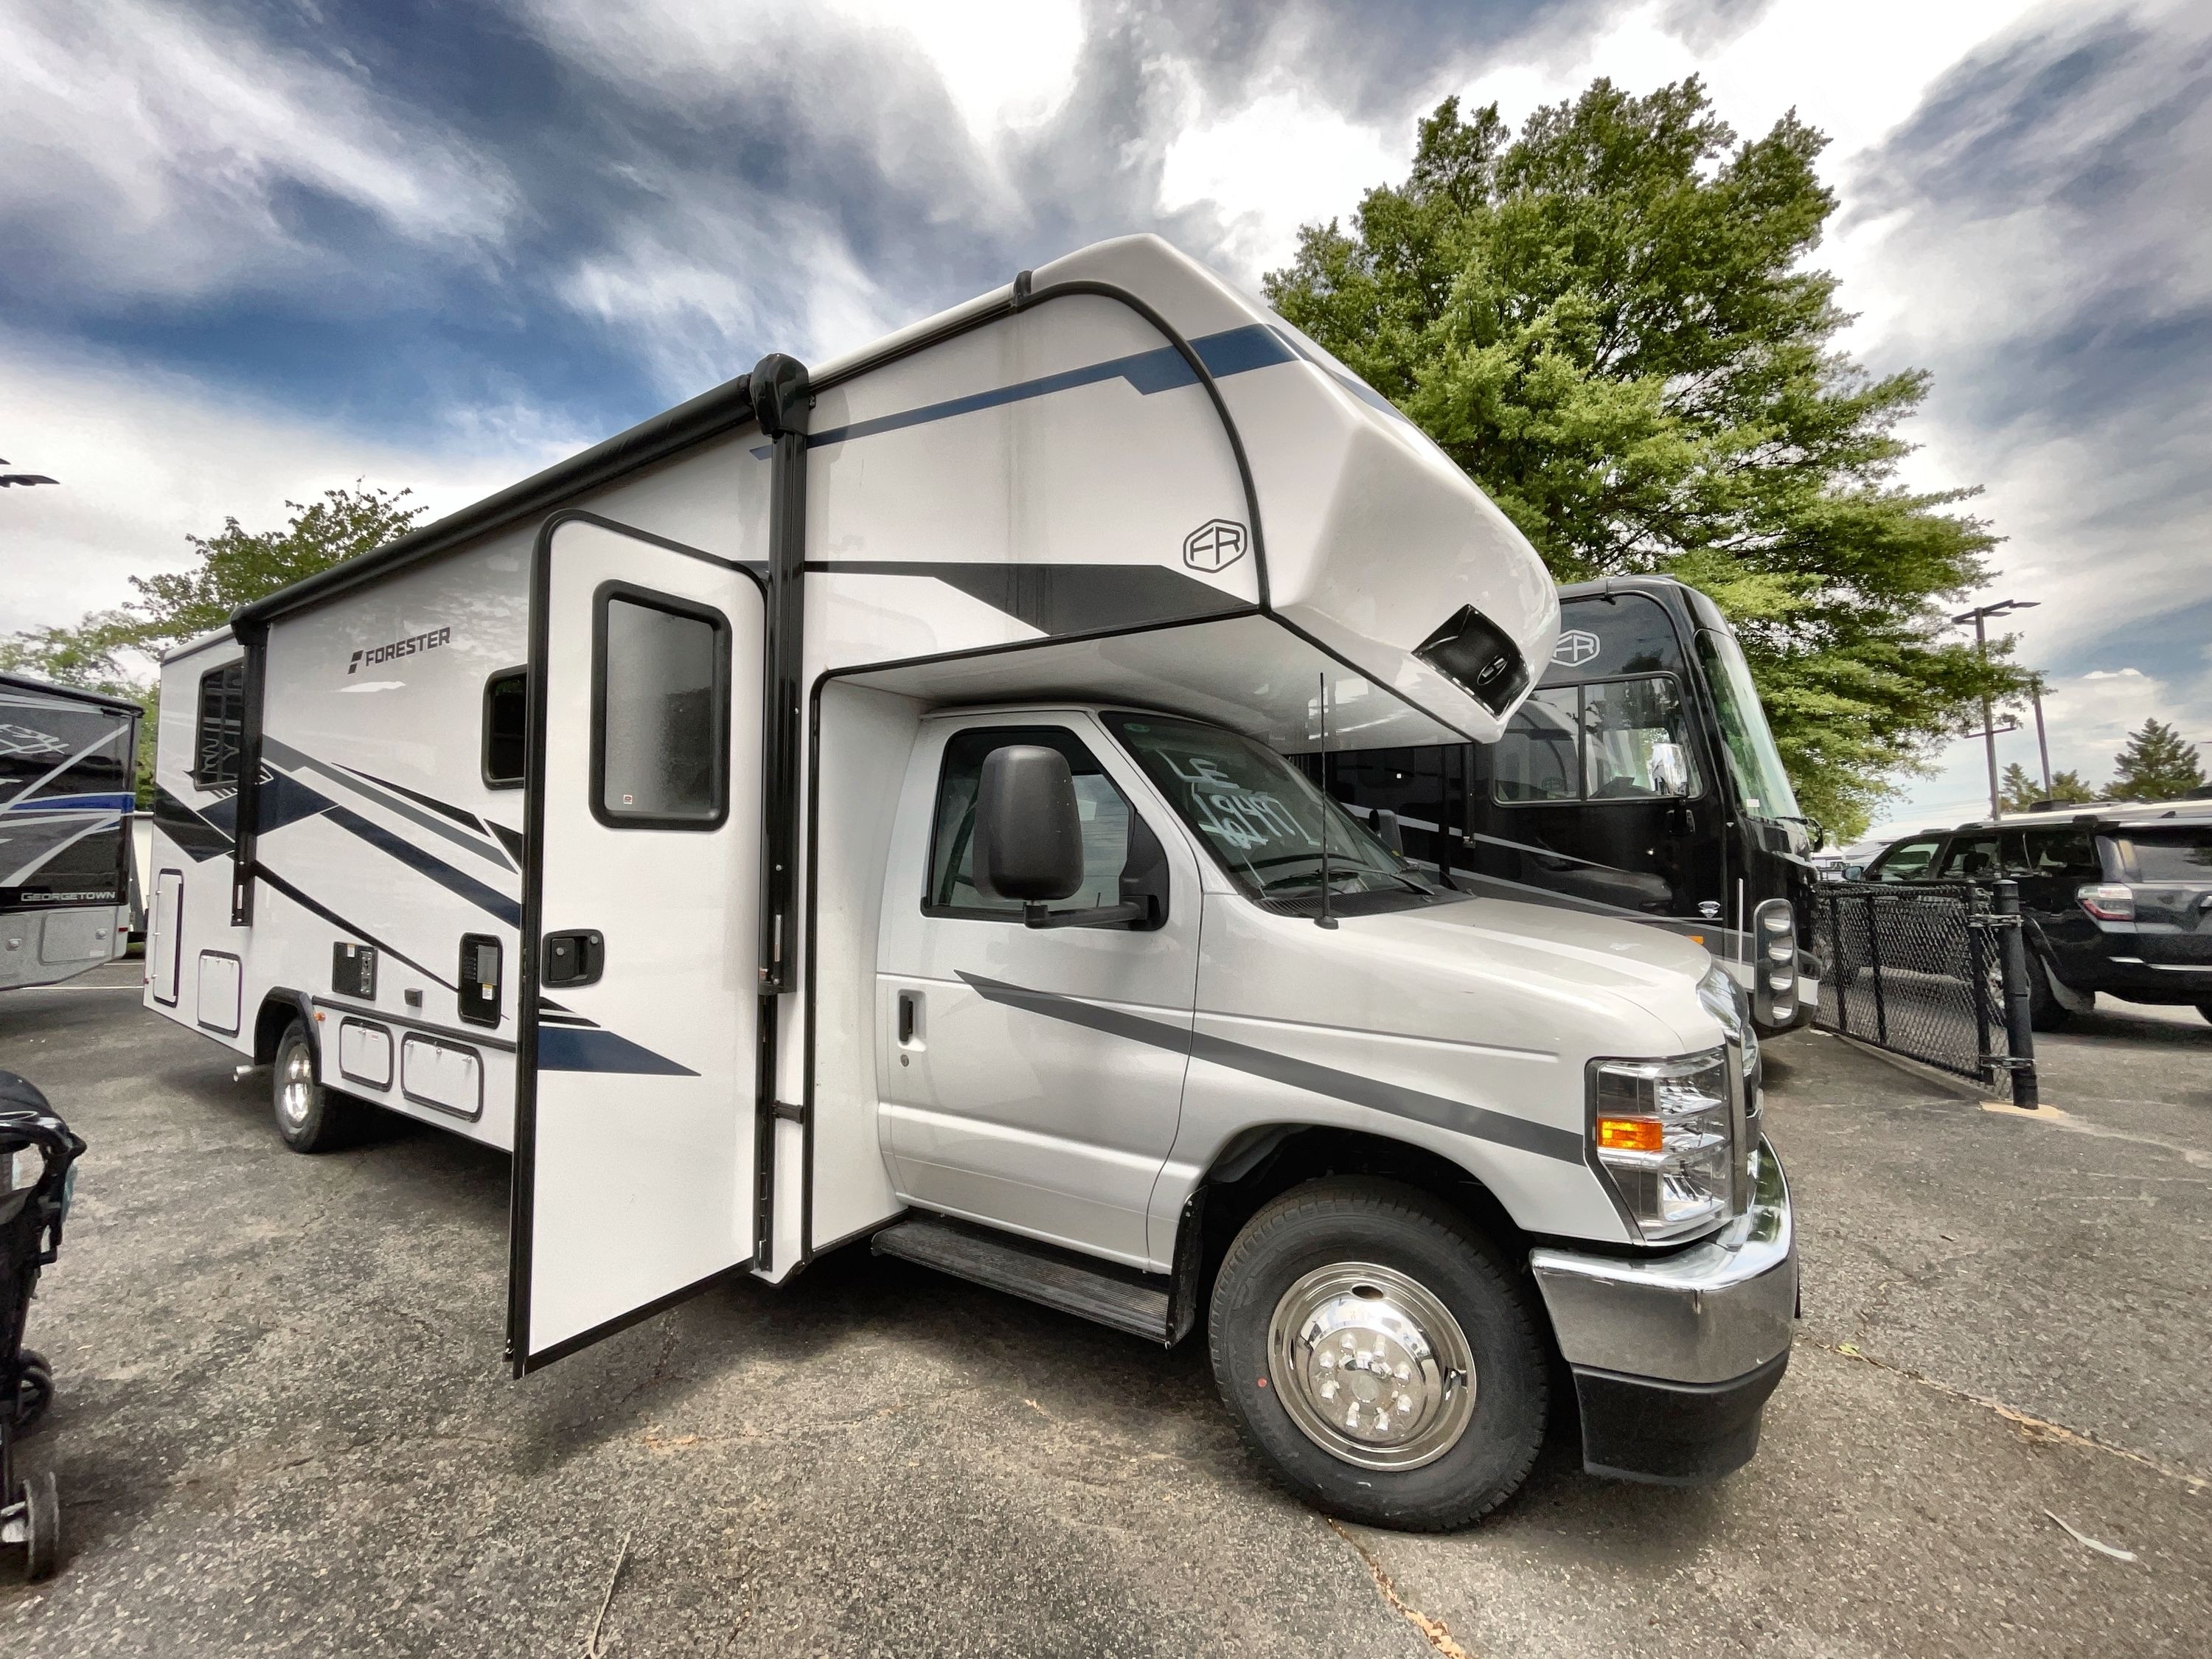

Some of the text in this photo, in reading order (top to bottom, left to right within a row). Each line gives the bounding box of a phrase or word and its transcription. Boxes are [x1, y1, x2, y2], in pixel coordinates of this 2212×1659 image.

[1189, 526, 1241, 566] FR
[365, 627, 451, 667] FORESTER
[1155, 748, 1240, 790] LE
[21, 891, 116, 901] GEORGETOWN
